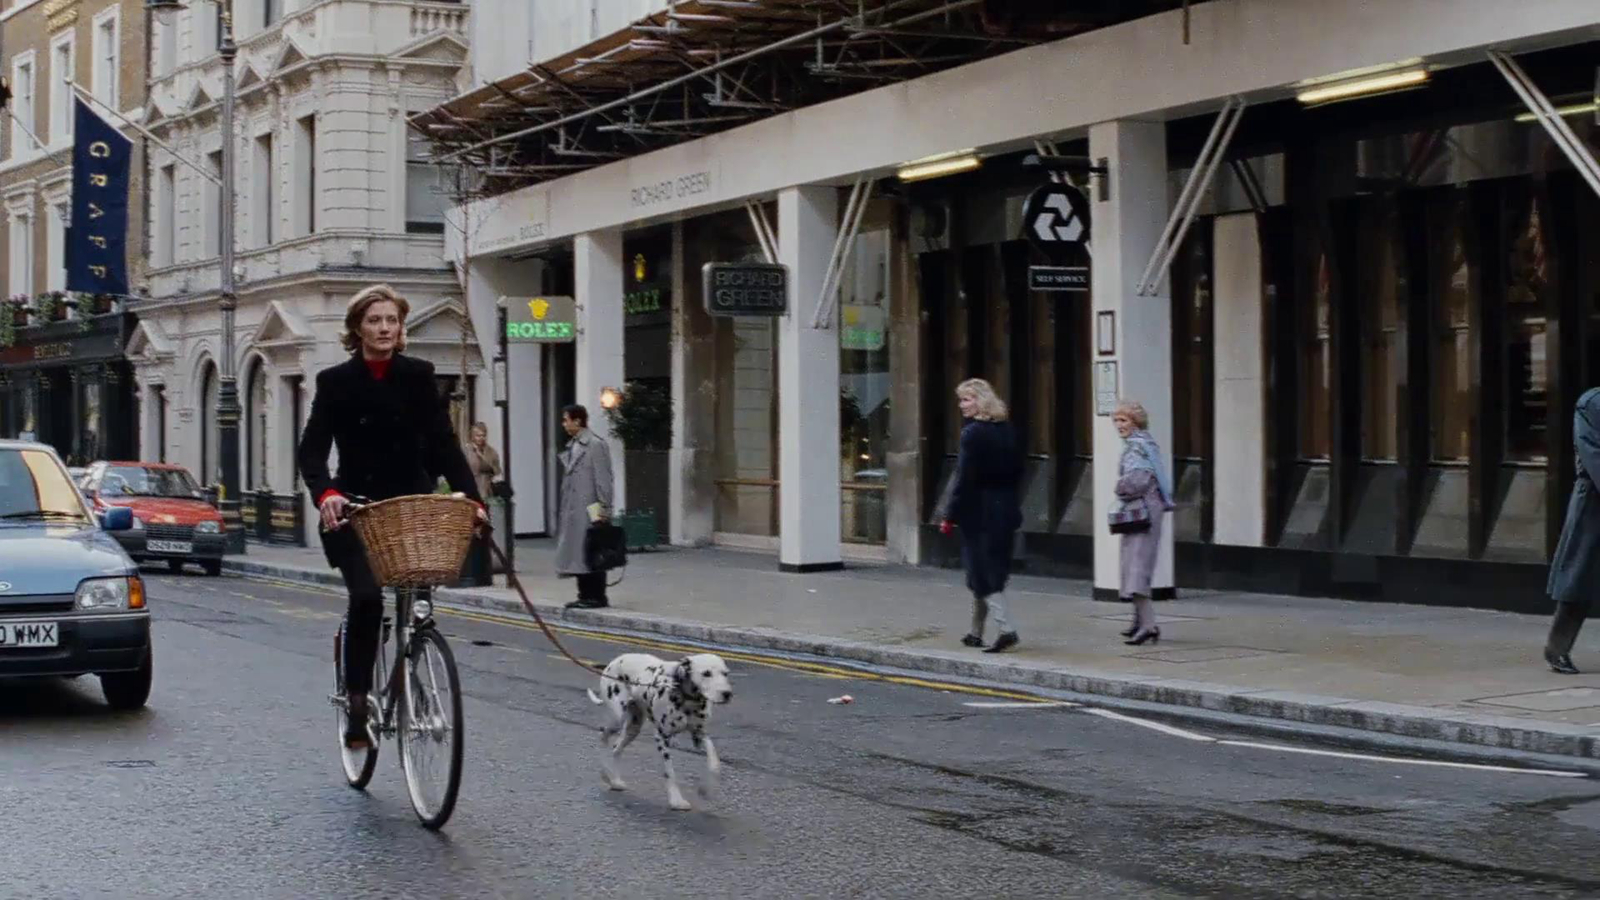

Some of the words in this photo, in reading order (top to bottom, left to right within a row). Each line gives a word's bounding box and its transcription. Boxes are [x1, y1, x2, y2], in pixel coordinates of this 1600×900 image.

[631, 182, 673, 208] RICHARD
[676, 171, 710, 198] GREEN
[88, 141, 110, 278] GRAFF
[715, 271, 783, 286] RICHARD
[1035, 274, 1054, 283] SELF
[715, 289, 784, 306] GREEN
[506, 322, 574, 338] ROLEX
[13, 625, 54, 643] WMX
